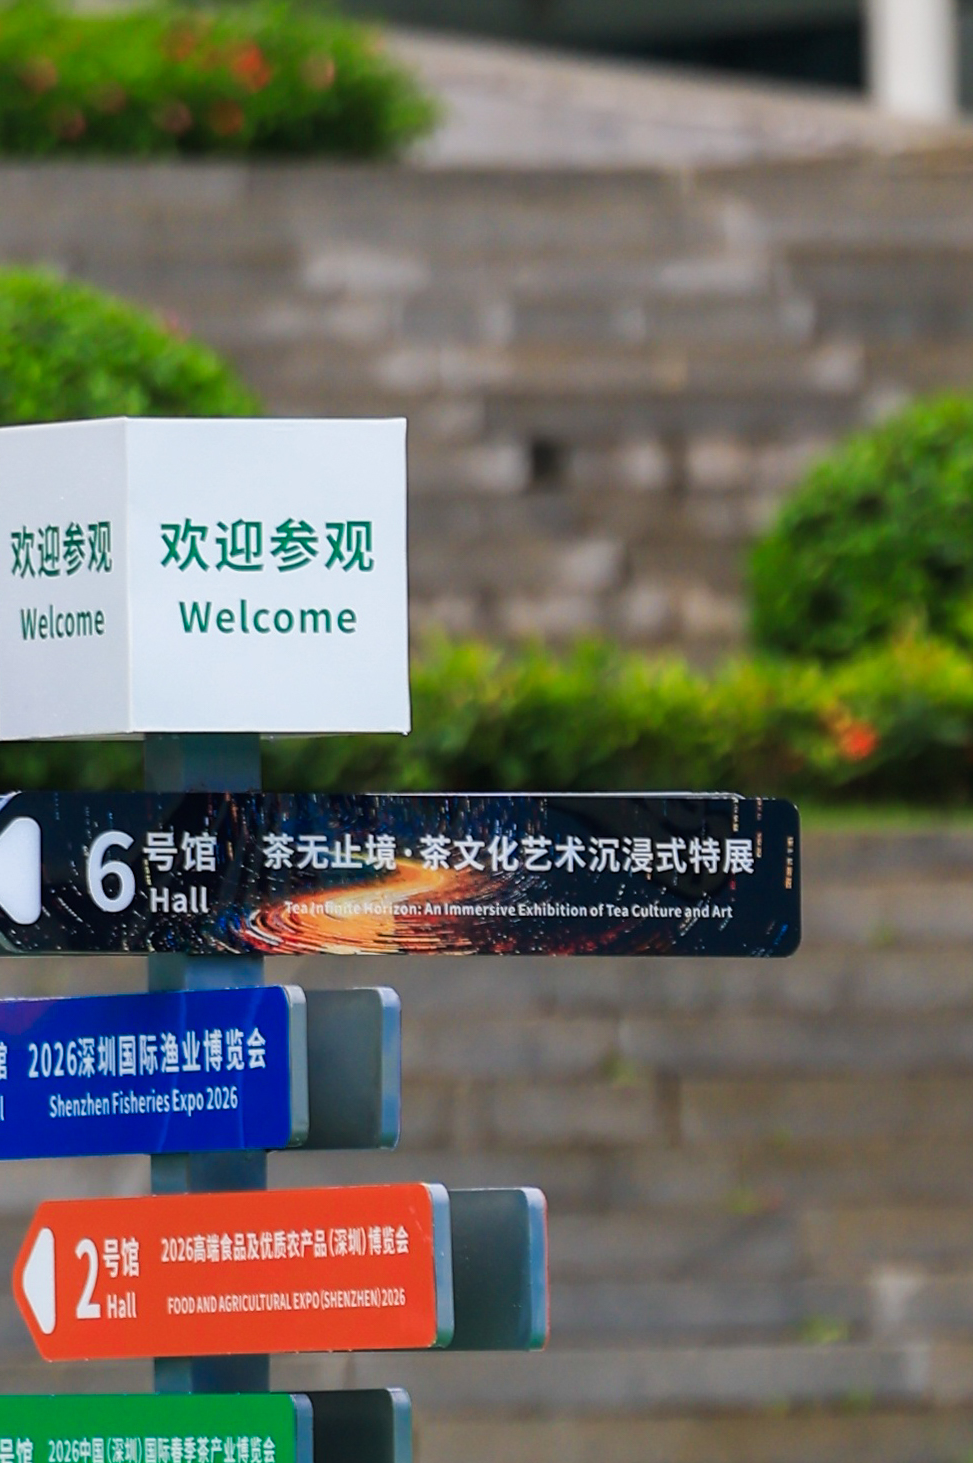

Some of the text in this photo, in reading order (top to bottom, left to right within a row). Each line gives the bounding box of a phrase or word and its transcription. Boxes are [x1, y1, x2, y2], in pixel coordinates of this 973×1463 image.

[10, 521, 113, 579] 欢迎参观
[160, 518, 375, 573] 欢迎参观
[21, 605, 106, 641] Welcome
[179, 599, 358, 634] Welcome
[86, 830, 136, 913] 6
[143, 832, 216, 873] 号馆
[262, 834, 755, 875] 茶无止境·茶文化艺术沉浸式特展
[149, 888, 209, 914] Hall
[284, 901, 308, 916] Tea
[363, 901, 422, 916] Horizon:
[424, 902, 442, 916] An
[444, 903, 516, 917] Immersive
[518, 903, 588, 918] Exhibition
[590, 903, 605, 917] of
[606, 903, 629, 918] Tea
[631, 904, 682, 918] Culture
[684, 904, 710, 918] and
[712, 904, 734, 918] Art
[27, 1027, 267, 1079] 2026深圳国际渔业博览会
[49, 1086, 239, 1118] Shenzhen Fisheries Expo 2026
[102, 1237, 140, 1278] 号馆
[74, 1238, 101, 1319] 2
[107, 1292, 137, 1319] Hall
[167, 1296, 196, 1314] FOOD
[196, 1294, 218, 1313] AND
[218, 1291, 292, 1312] AGRICULTURAL
